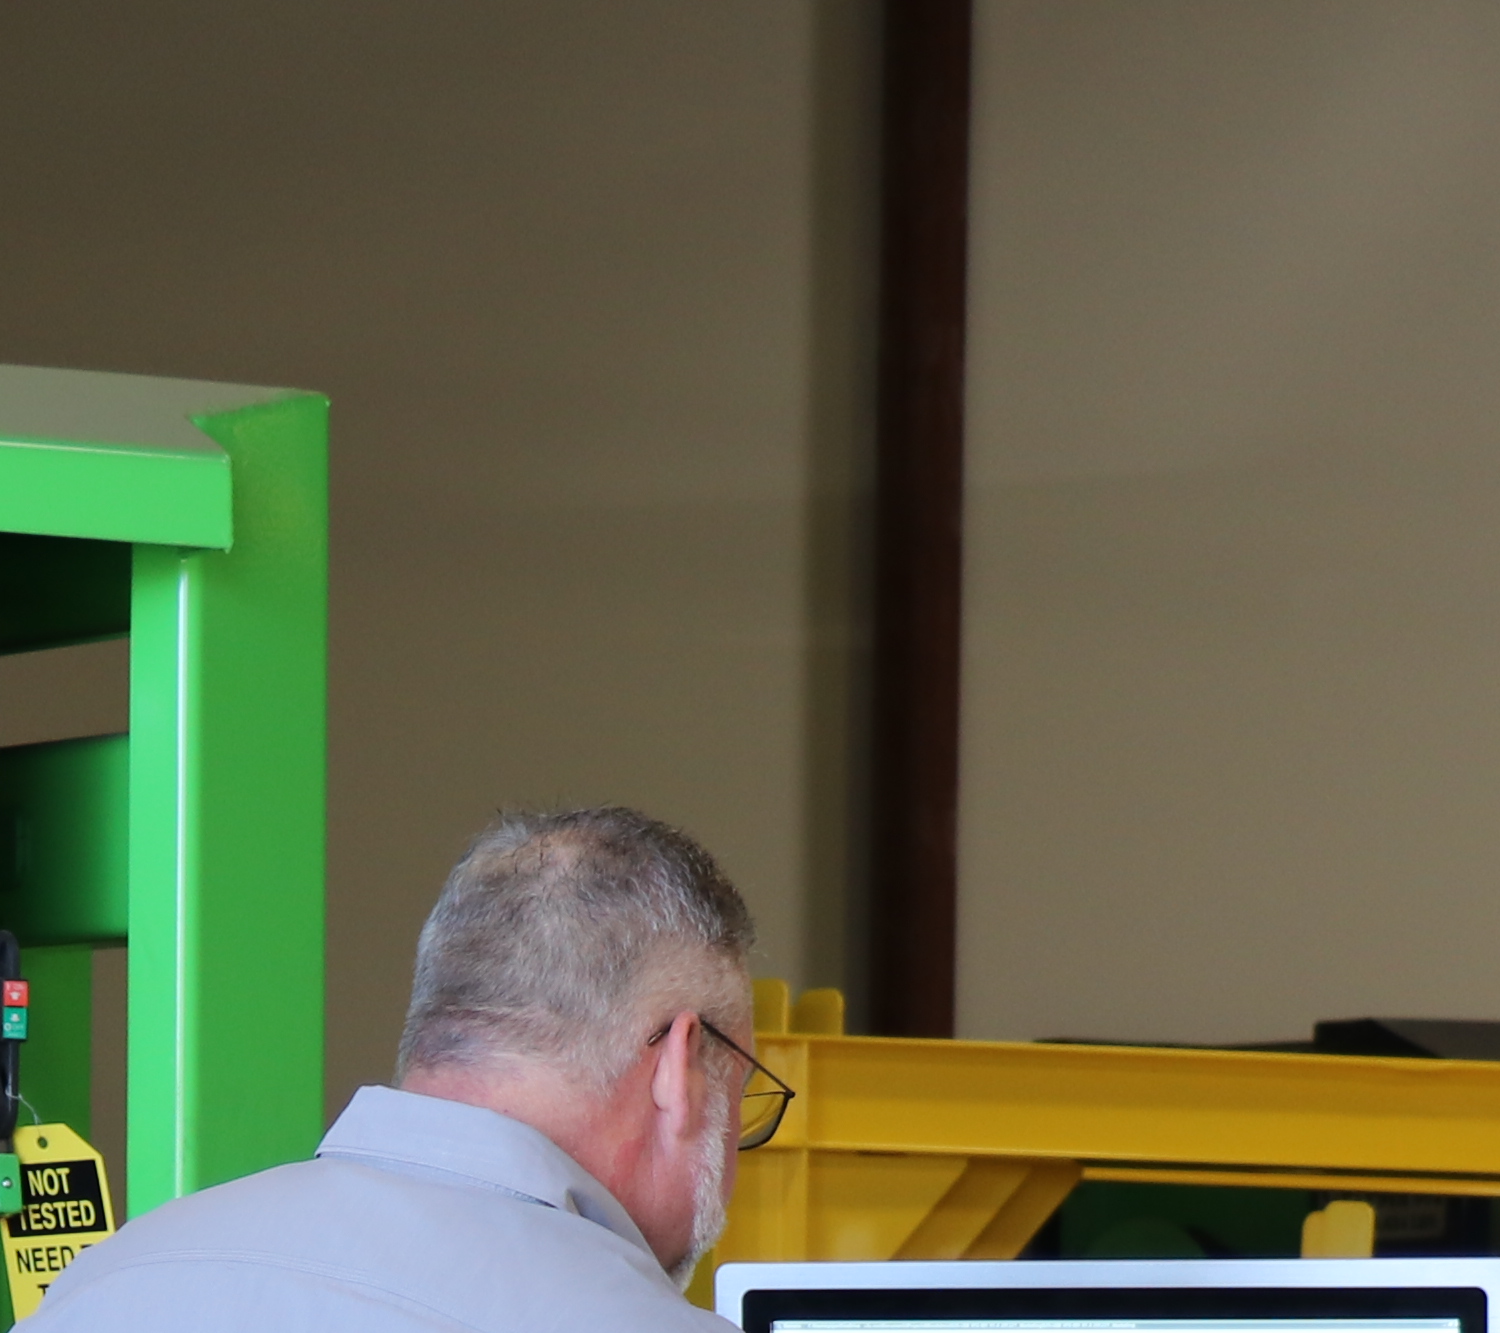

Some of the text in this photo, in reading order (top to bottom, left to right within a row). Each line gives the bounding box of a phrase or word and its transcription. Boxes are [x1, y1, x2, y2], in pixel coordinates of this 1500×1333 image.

[27, 1167, 70, 1197] NOT
[21, 1200, 96, 1231] TESTED
[16, 1245, 75, 1274] NEED
